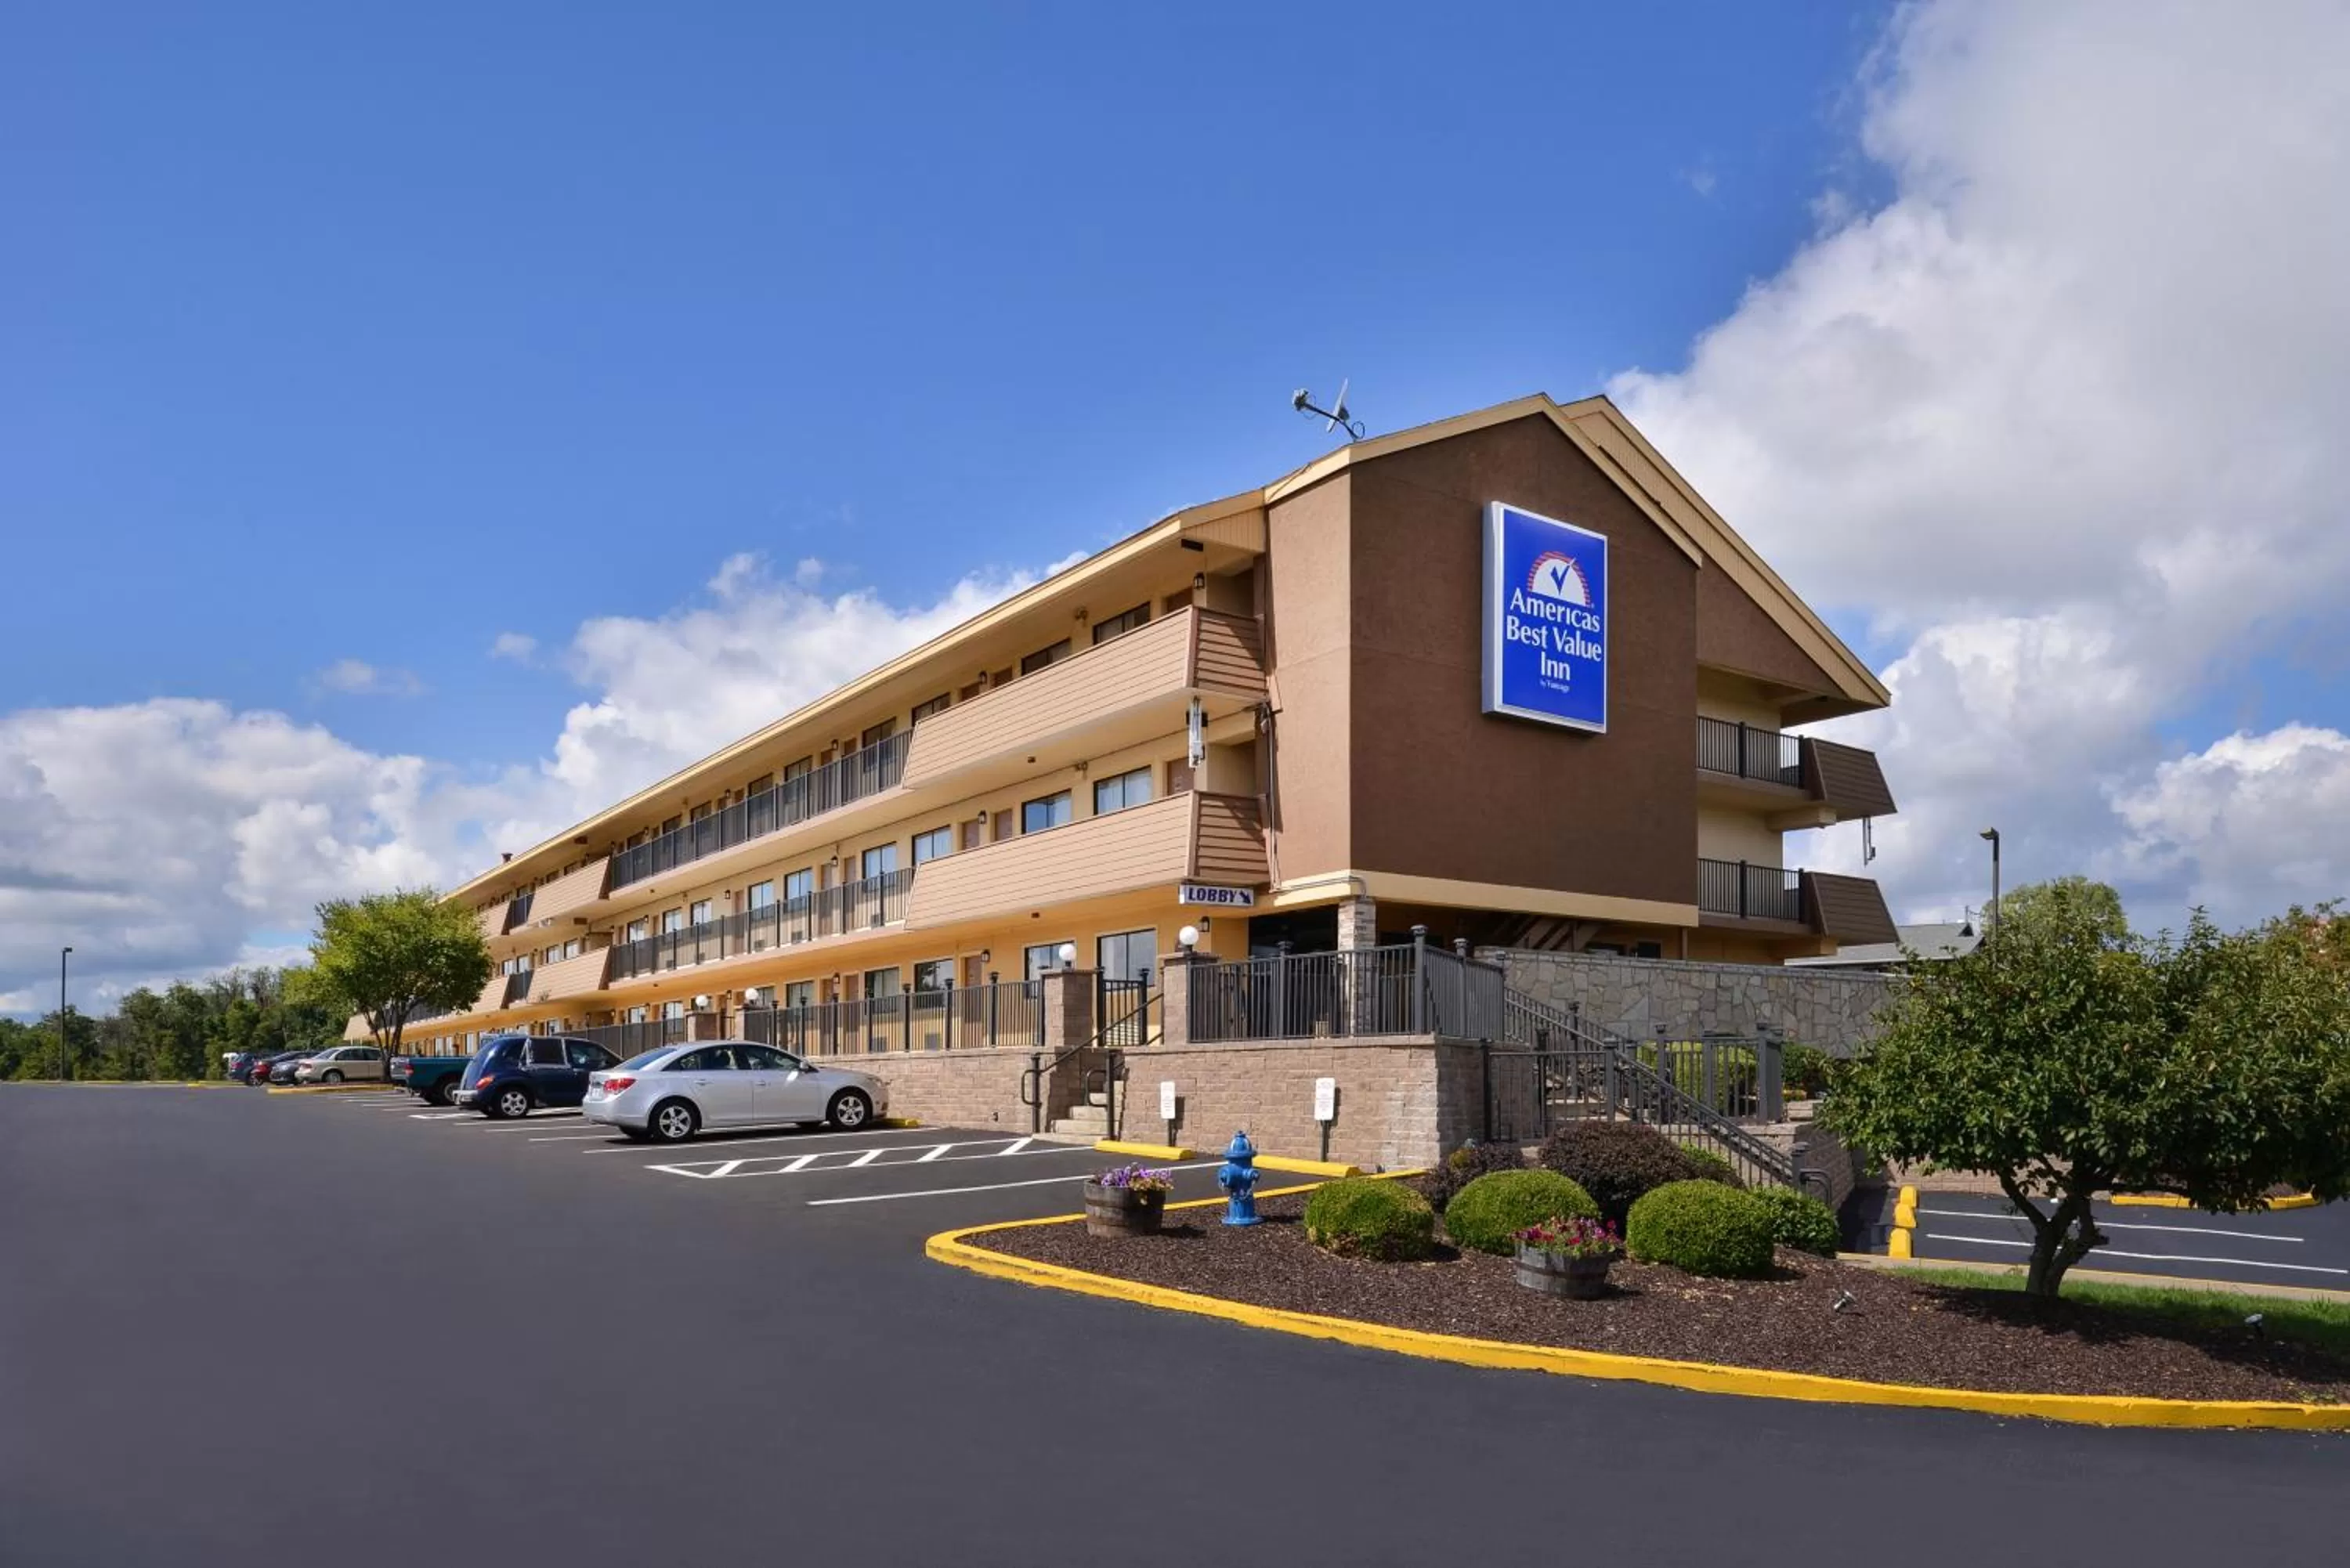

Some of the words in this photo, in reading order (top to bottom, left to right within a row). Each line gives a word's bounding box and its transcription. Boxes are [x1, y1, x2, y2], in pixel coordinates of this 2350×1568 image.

[1509, 587, 1600, 632] Americas
[1506, 615, 1548, 649] Best
[1553, 627, 1602, 662] Value
[1541, 651, 1571, 681] Inn
[1188, 887, 1237, 903] LOBBY
